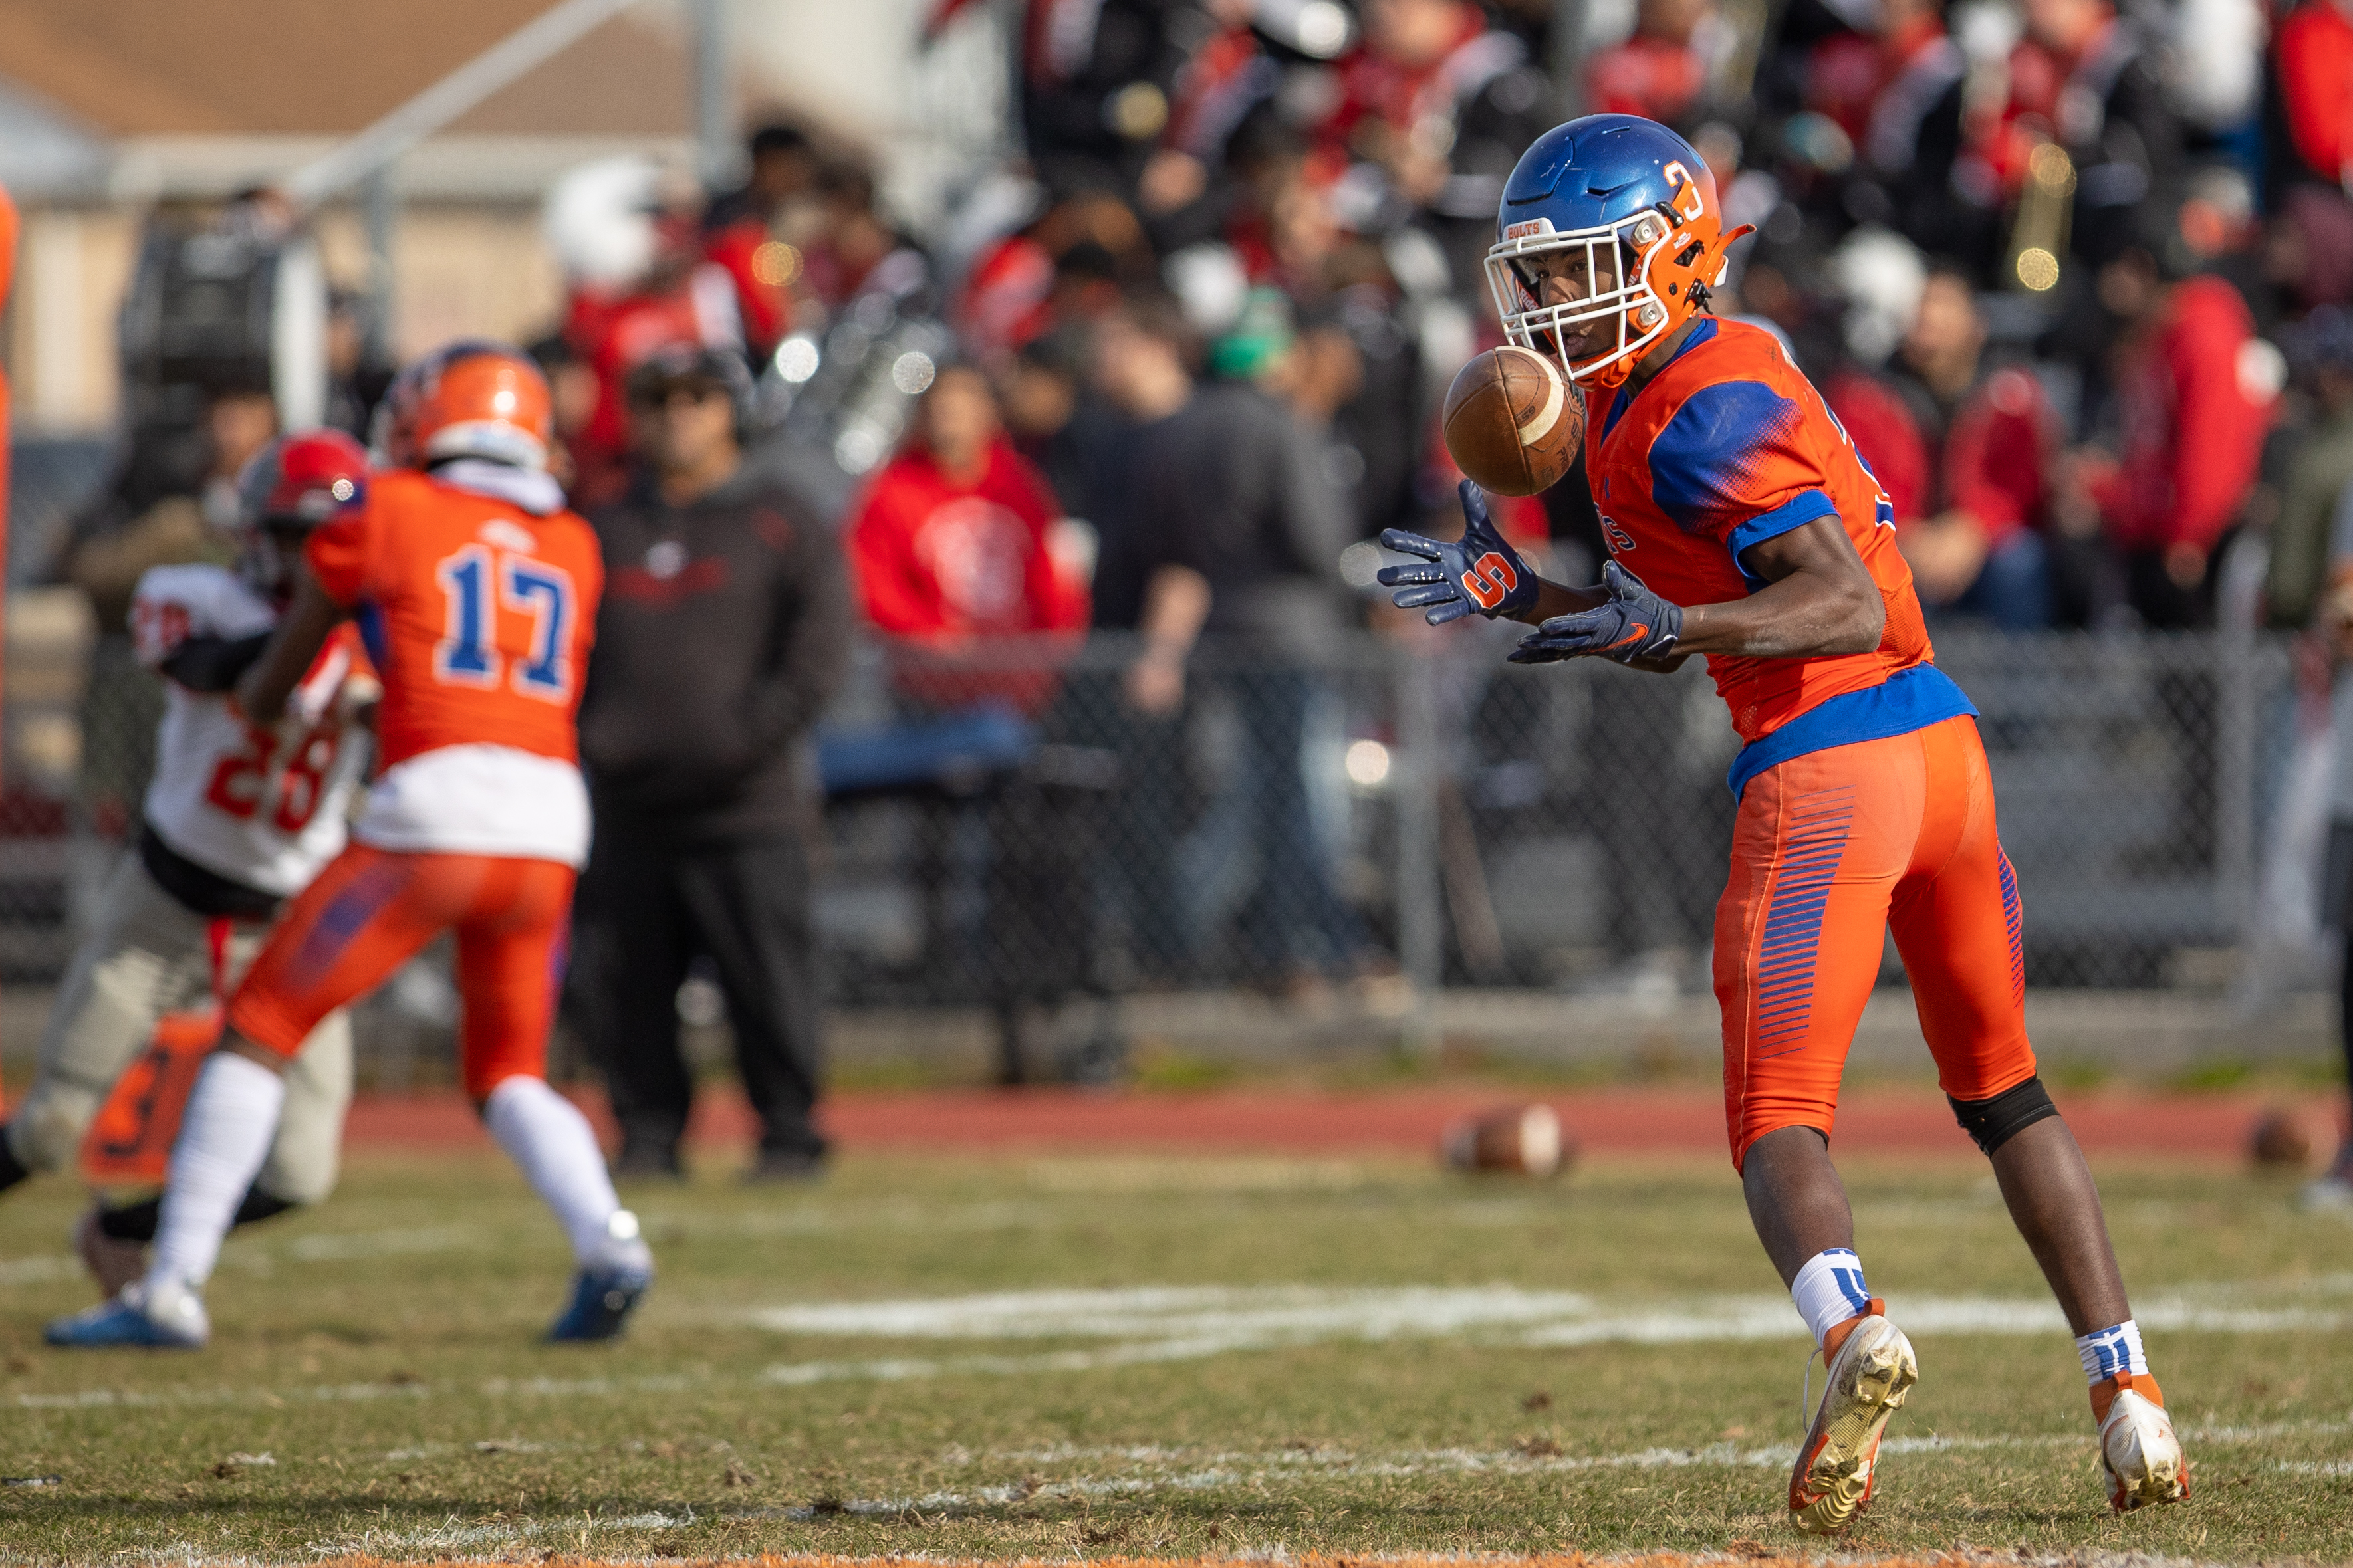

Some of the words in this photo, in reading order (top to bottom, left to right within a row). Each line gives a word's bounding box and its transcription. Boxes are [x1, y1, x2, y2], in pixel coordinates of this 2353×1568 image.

[1508, 222, 1540, 240] BOLTS
[1461, 551, 1518, 610] S
[434, 545, 577, 703] 17
